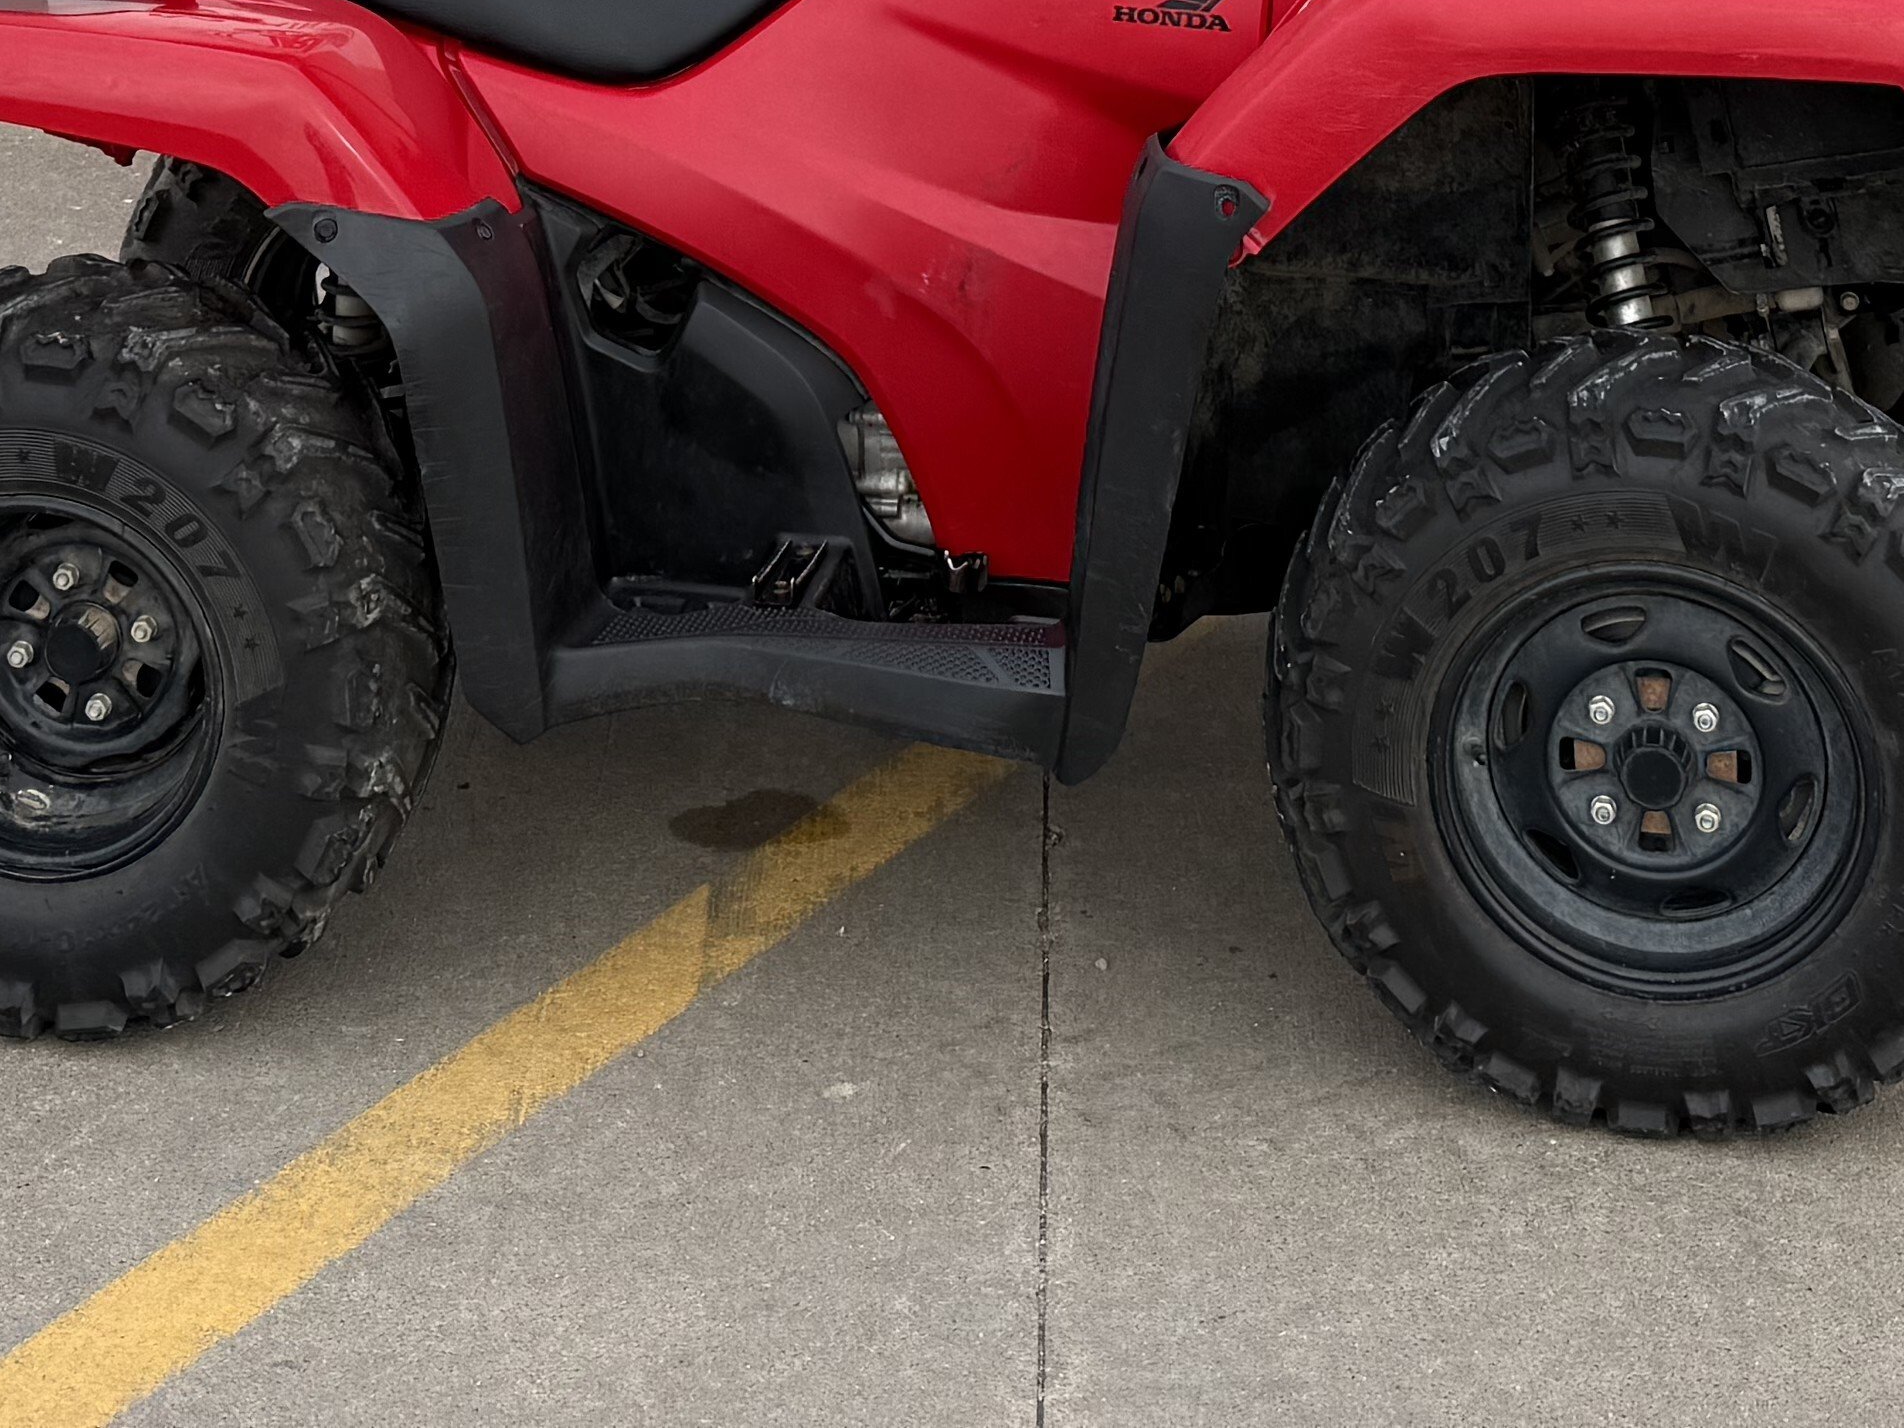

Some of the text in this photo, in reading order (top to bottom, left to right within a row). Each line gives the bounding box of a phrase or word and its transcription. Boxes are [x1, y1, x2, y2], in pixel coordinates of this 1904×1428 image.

[1112, 5, 1232, 33] HONDA
[119, 475, 242, 577] 207
[1425, 512, 1543, 621] 207
